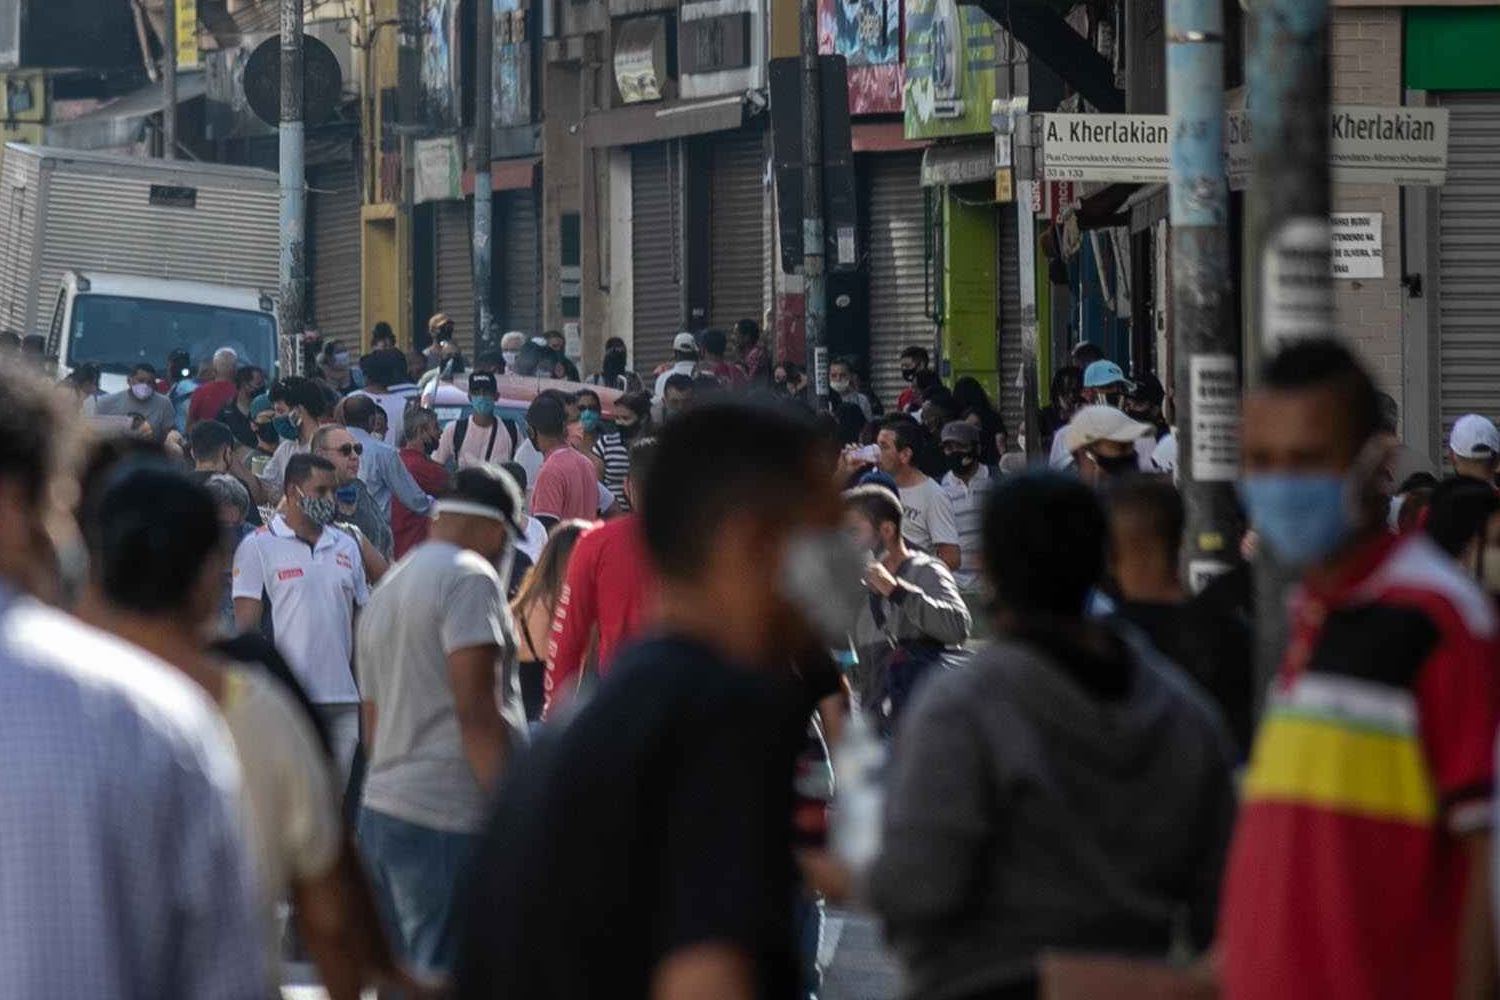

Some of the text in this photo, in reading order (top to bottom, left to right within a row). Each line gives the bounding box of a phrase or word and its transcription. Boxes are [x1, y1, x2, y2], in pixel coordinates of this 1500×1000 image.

[1046, 120, 1168, 144] A. Kherlakian
[1331, 113, 1435, 142] Kherlakian
